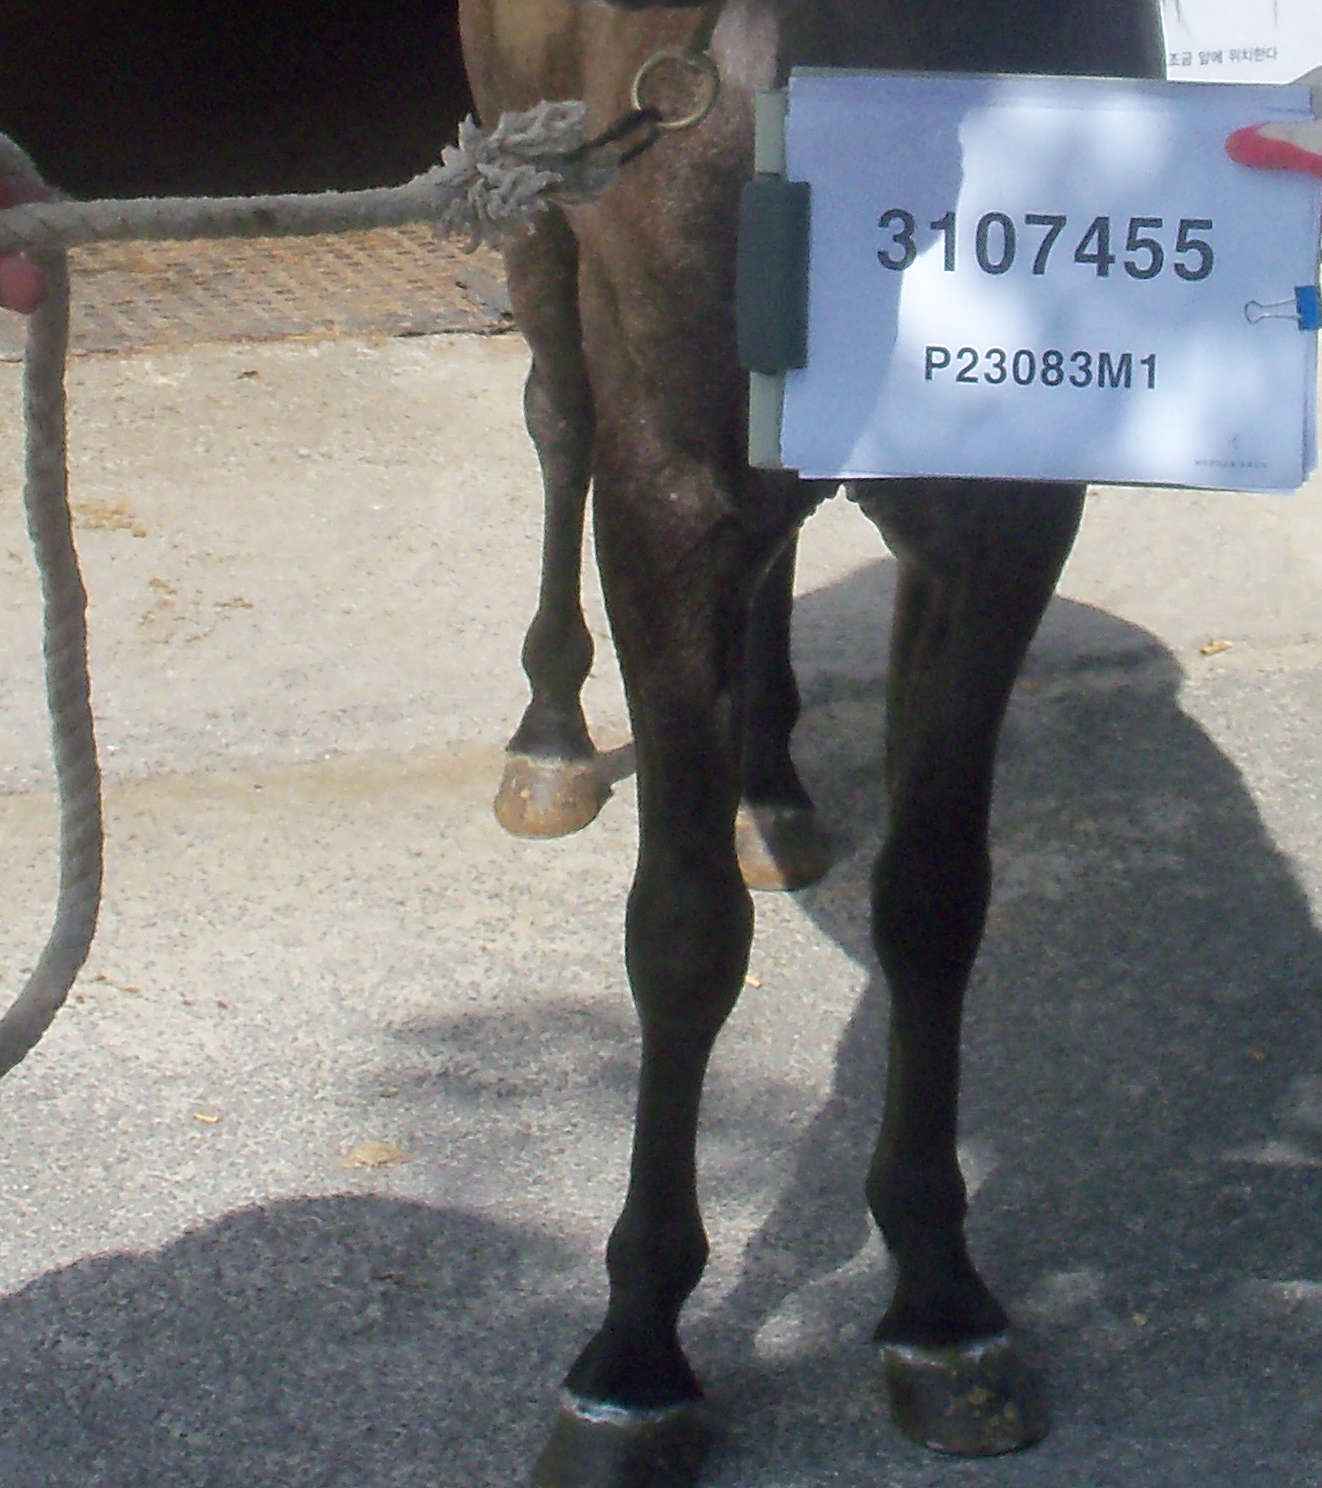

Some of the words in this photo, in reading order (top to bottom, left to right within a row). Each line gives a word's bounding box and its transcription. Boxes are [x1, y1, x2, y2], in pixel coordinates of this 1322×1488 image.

[1168, 51, 1193, 67] 조금
[1198, 49, 1224, 66] 앞에
[876, 207, 1216, 282] 3107455
[923, 345, 1158, 390] P23083M1
